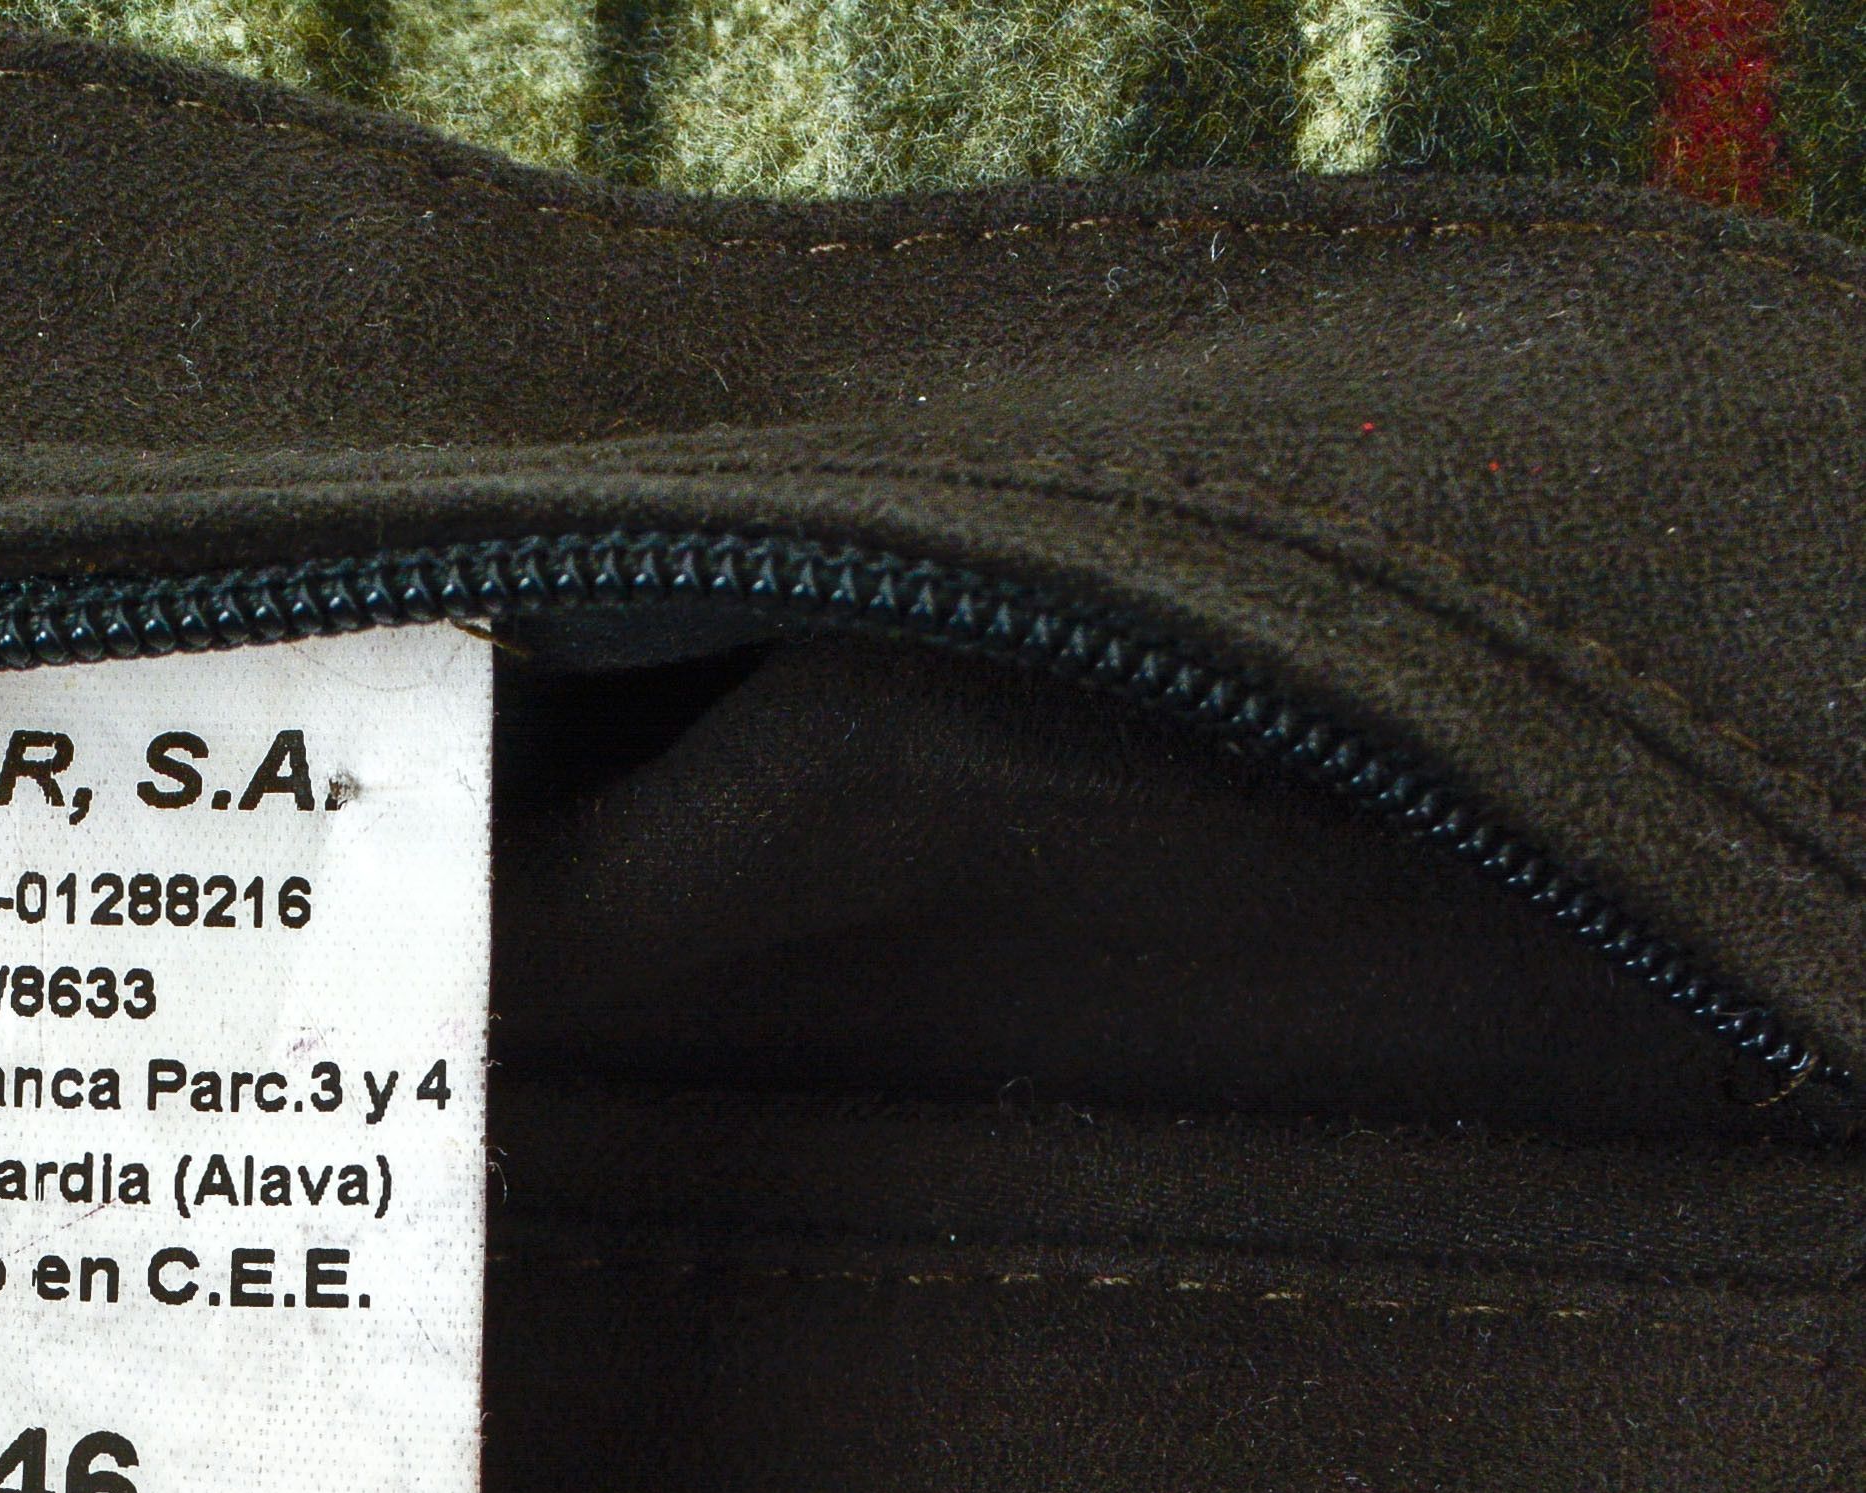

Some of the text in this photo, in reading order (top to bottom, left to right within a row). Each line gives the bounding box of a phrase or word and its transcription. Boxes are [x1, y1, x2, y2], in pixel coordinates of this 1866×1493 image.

[137, 730, 347, 811] S.A.
[147, 1059, 342, 1112] Parc.3
[364, 1071, 398, 1124] y
[417, 1059, 451, 1109] 4
[175, 1154, 391, 1218] (Alava)
[32, 1255, 119, 1302] en
[148, 1247, 370, 1308] C.E.E.
